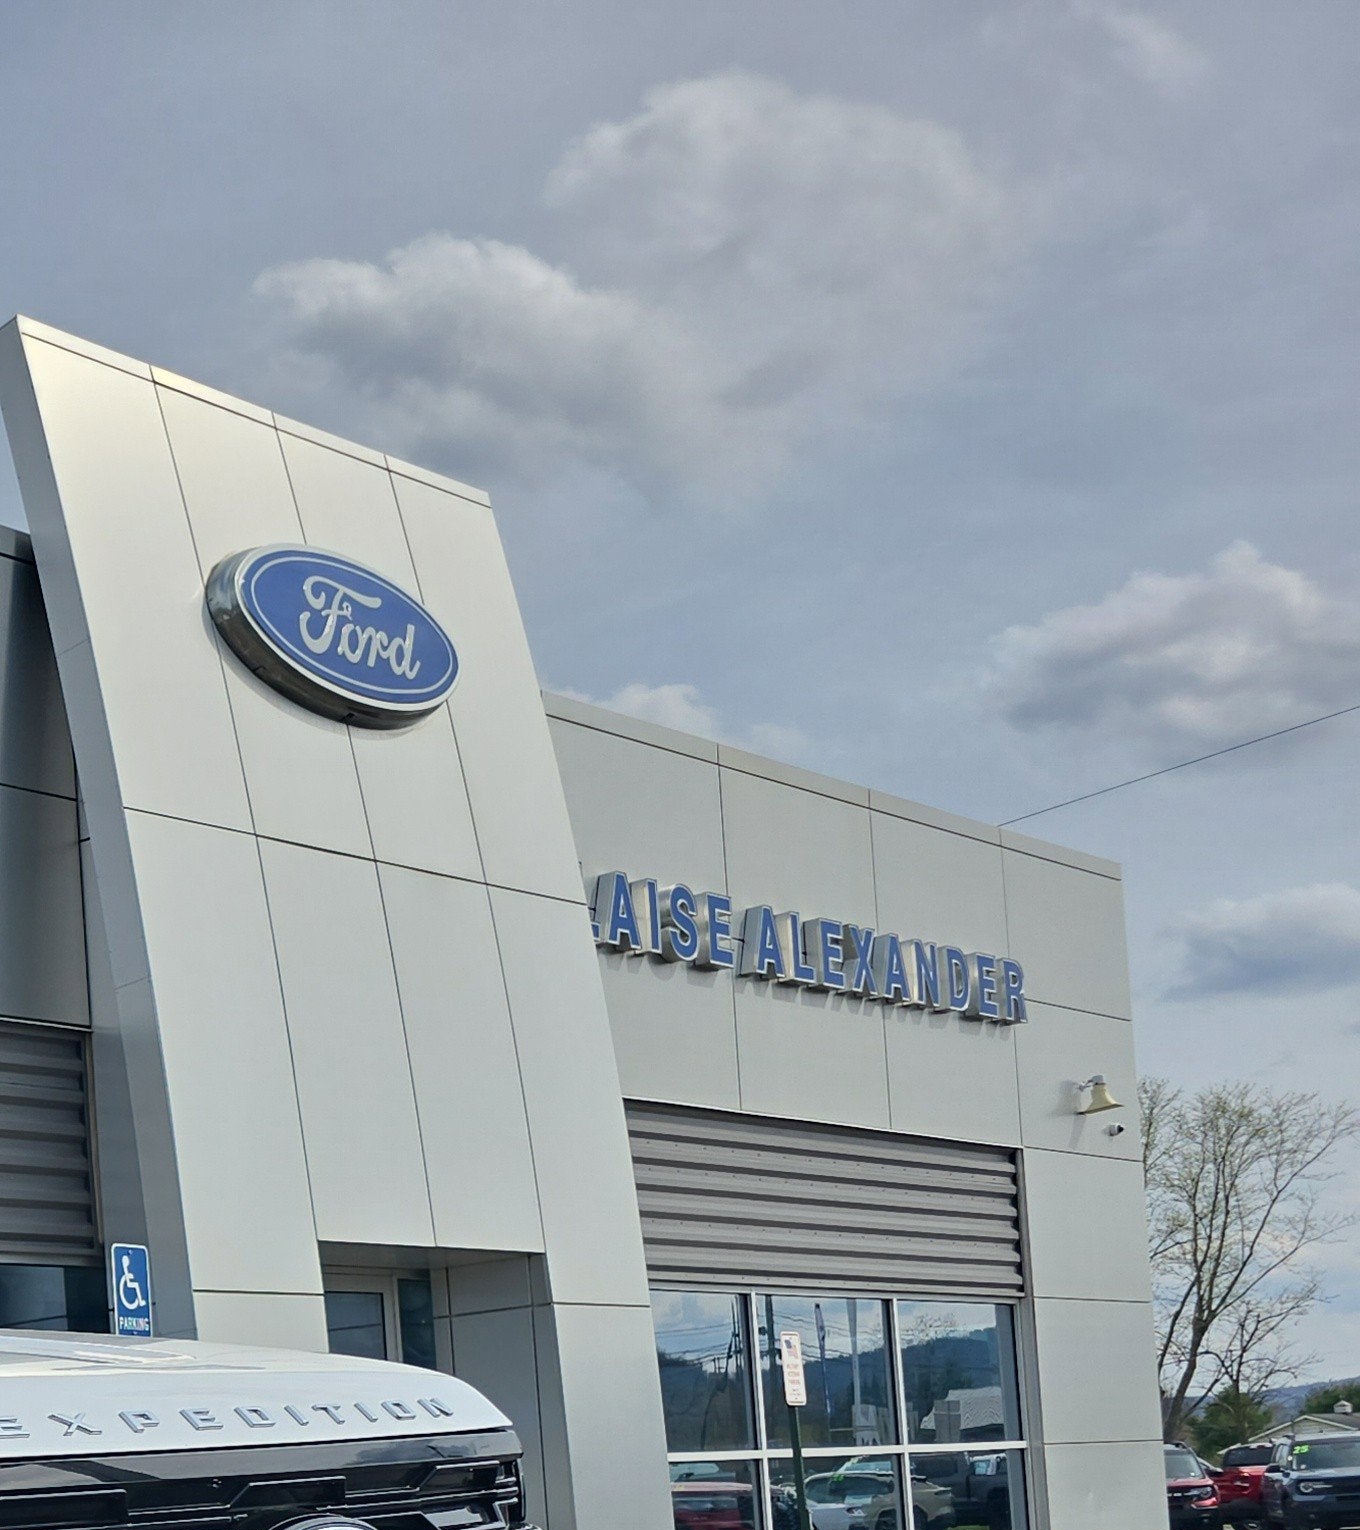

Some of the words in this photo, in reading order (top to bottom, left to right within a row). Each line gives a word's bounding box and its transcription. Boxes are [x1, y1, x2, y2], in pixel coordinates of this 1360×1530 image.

[299, 575, 421, 680] Ford
[742, 904, 1028, 1026] ALEXANDER
[119, 1316, 150, 1331] PARKING
